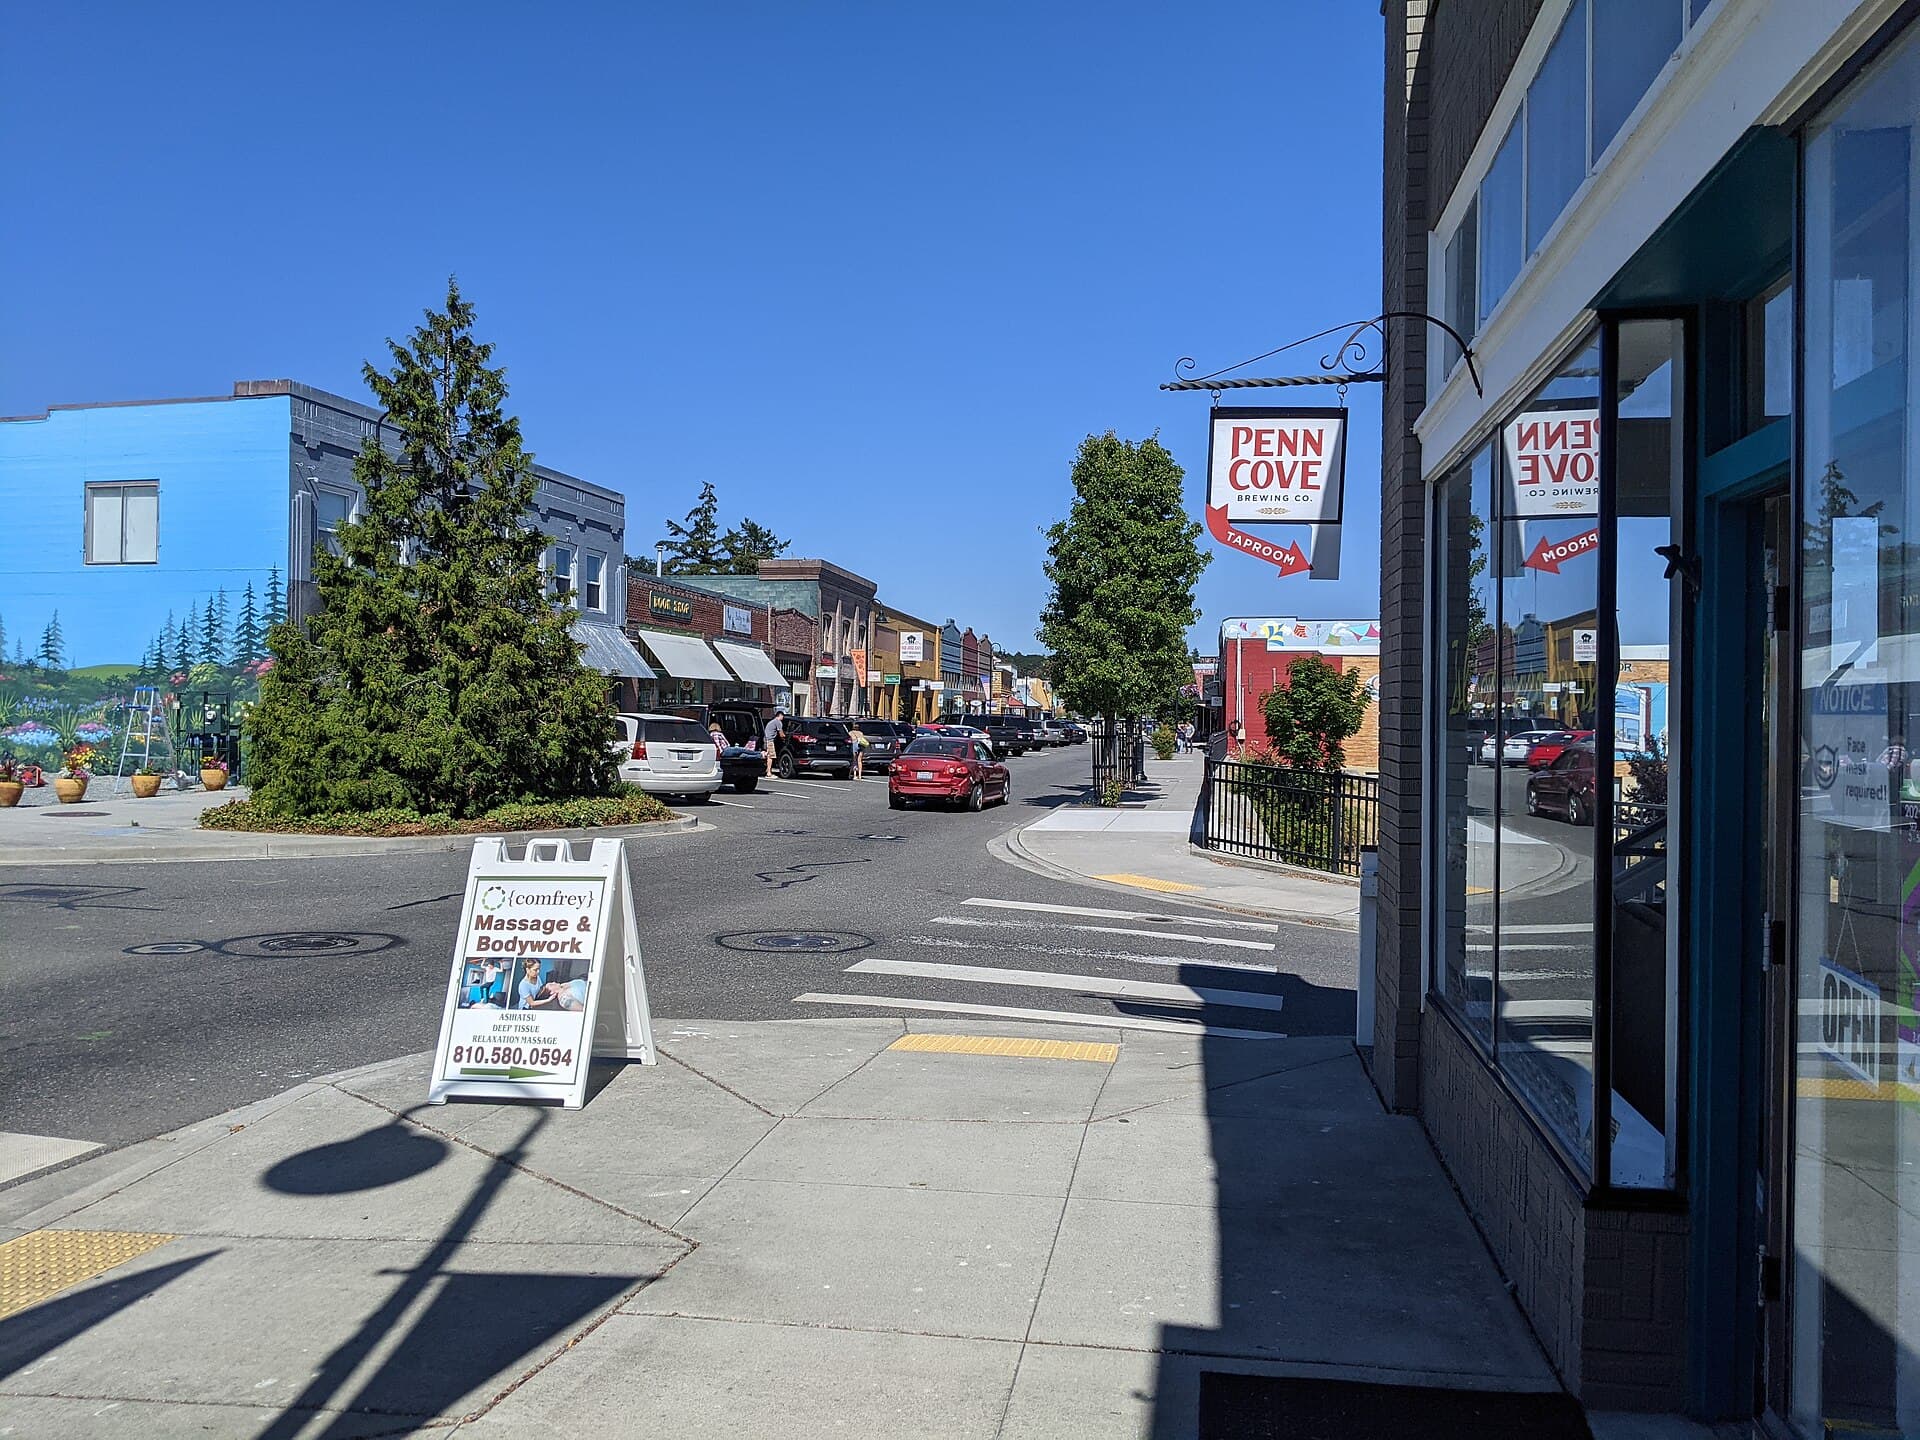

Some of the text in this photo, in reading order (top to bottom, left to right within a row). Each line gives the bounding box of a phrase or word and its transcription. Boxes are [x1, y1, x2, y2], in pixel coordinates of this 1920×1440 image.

[1231, 427, 1324, 460] PENN
[1229, 459, 1321, 490] COVE
[1237, 494, 1313, 502] BREWING CO.
[1226, 531, 1295, 566] TAPROOM
[1820, 684, 1875, 712] NOTICE
[1847, 736, 1866, 752] Face
[1845, 784, 1887, 801] required!
[474, 915, 591, 935] Massage &
[476, 936, 583, 956] Bodywork
[492, 1024, 541, 1033] DEEP TISSUE
[1822, 972, 1875, 1081] OPEN
[472, 1035, 558, 1045] RELAXATION MASSAGE
[453, 1045, 572, 1067] 810.580.0594
